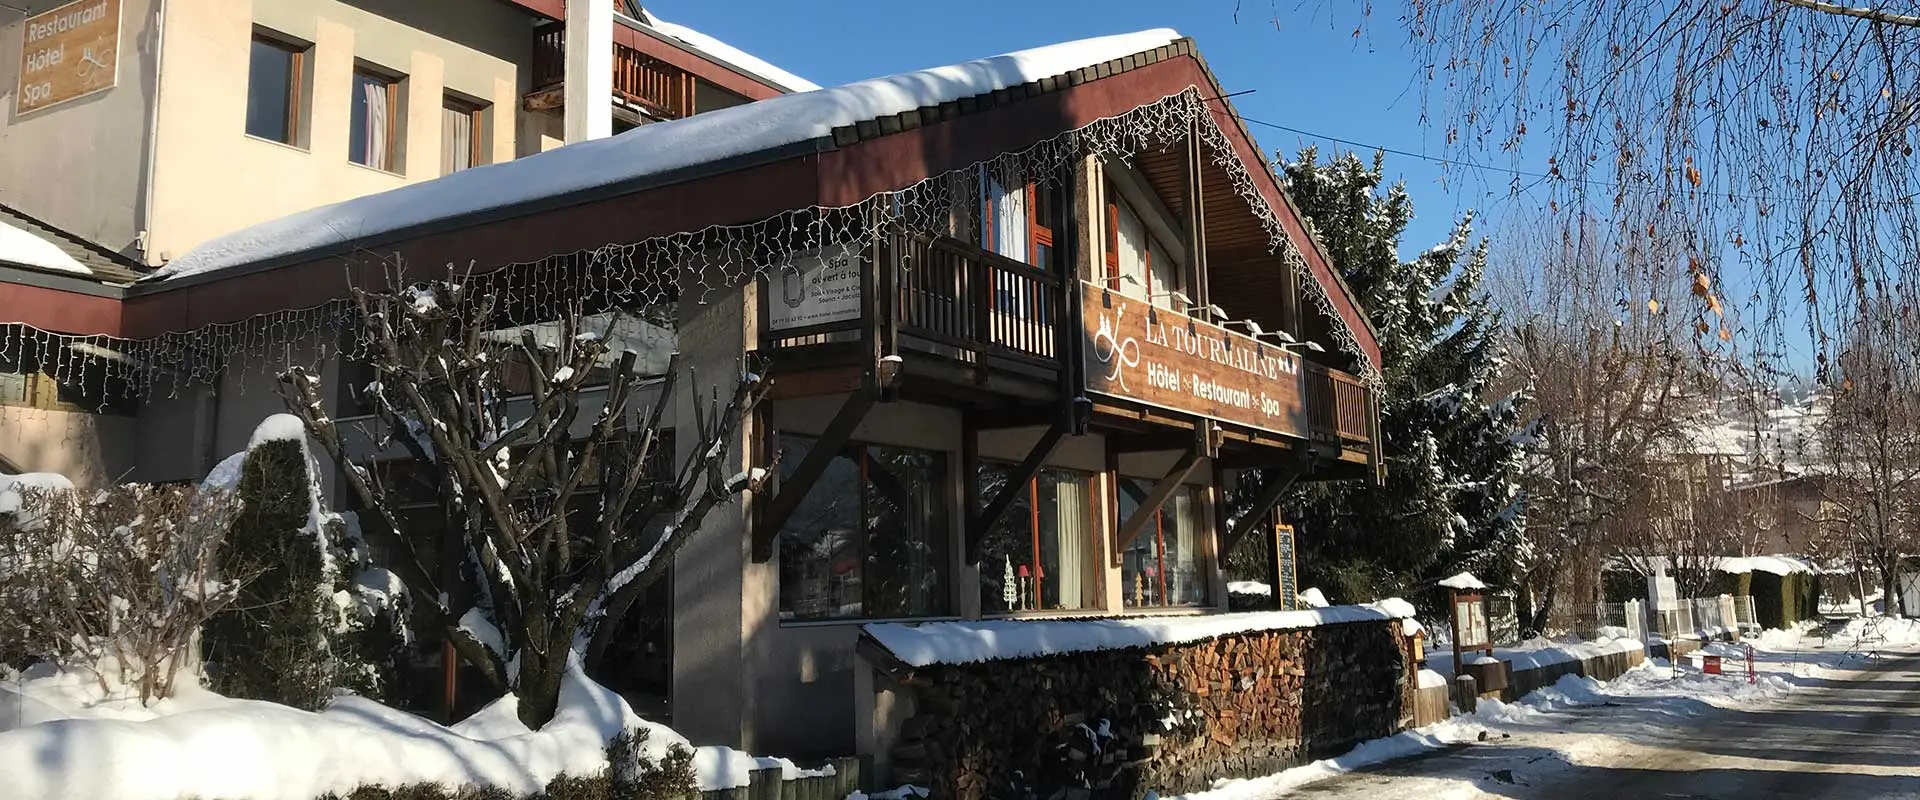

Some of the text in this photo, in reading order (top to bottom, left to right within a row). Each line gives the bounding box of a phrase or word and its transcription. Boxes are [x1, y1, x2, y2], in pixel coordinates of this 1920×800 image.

[28, 0, 107, 42] Restaurant
[26, 43, 64, 74] Hôtel
[23, 82, 51, 106] Spa
[829, 259, 848, 270] Spa
[1144, 316, 1278, 380] LA TOURMALINE
[1147, 361, 1280, 418] Hôtel Restaurant Spa
